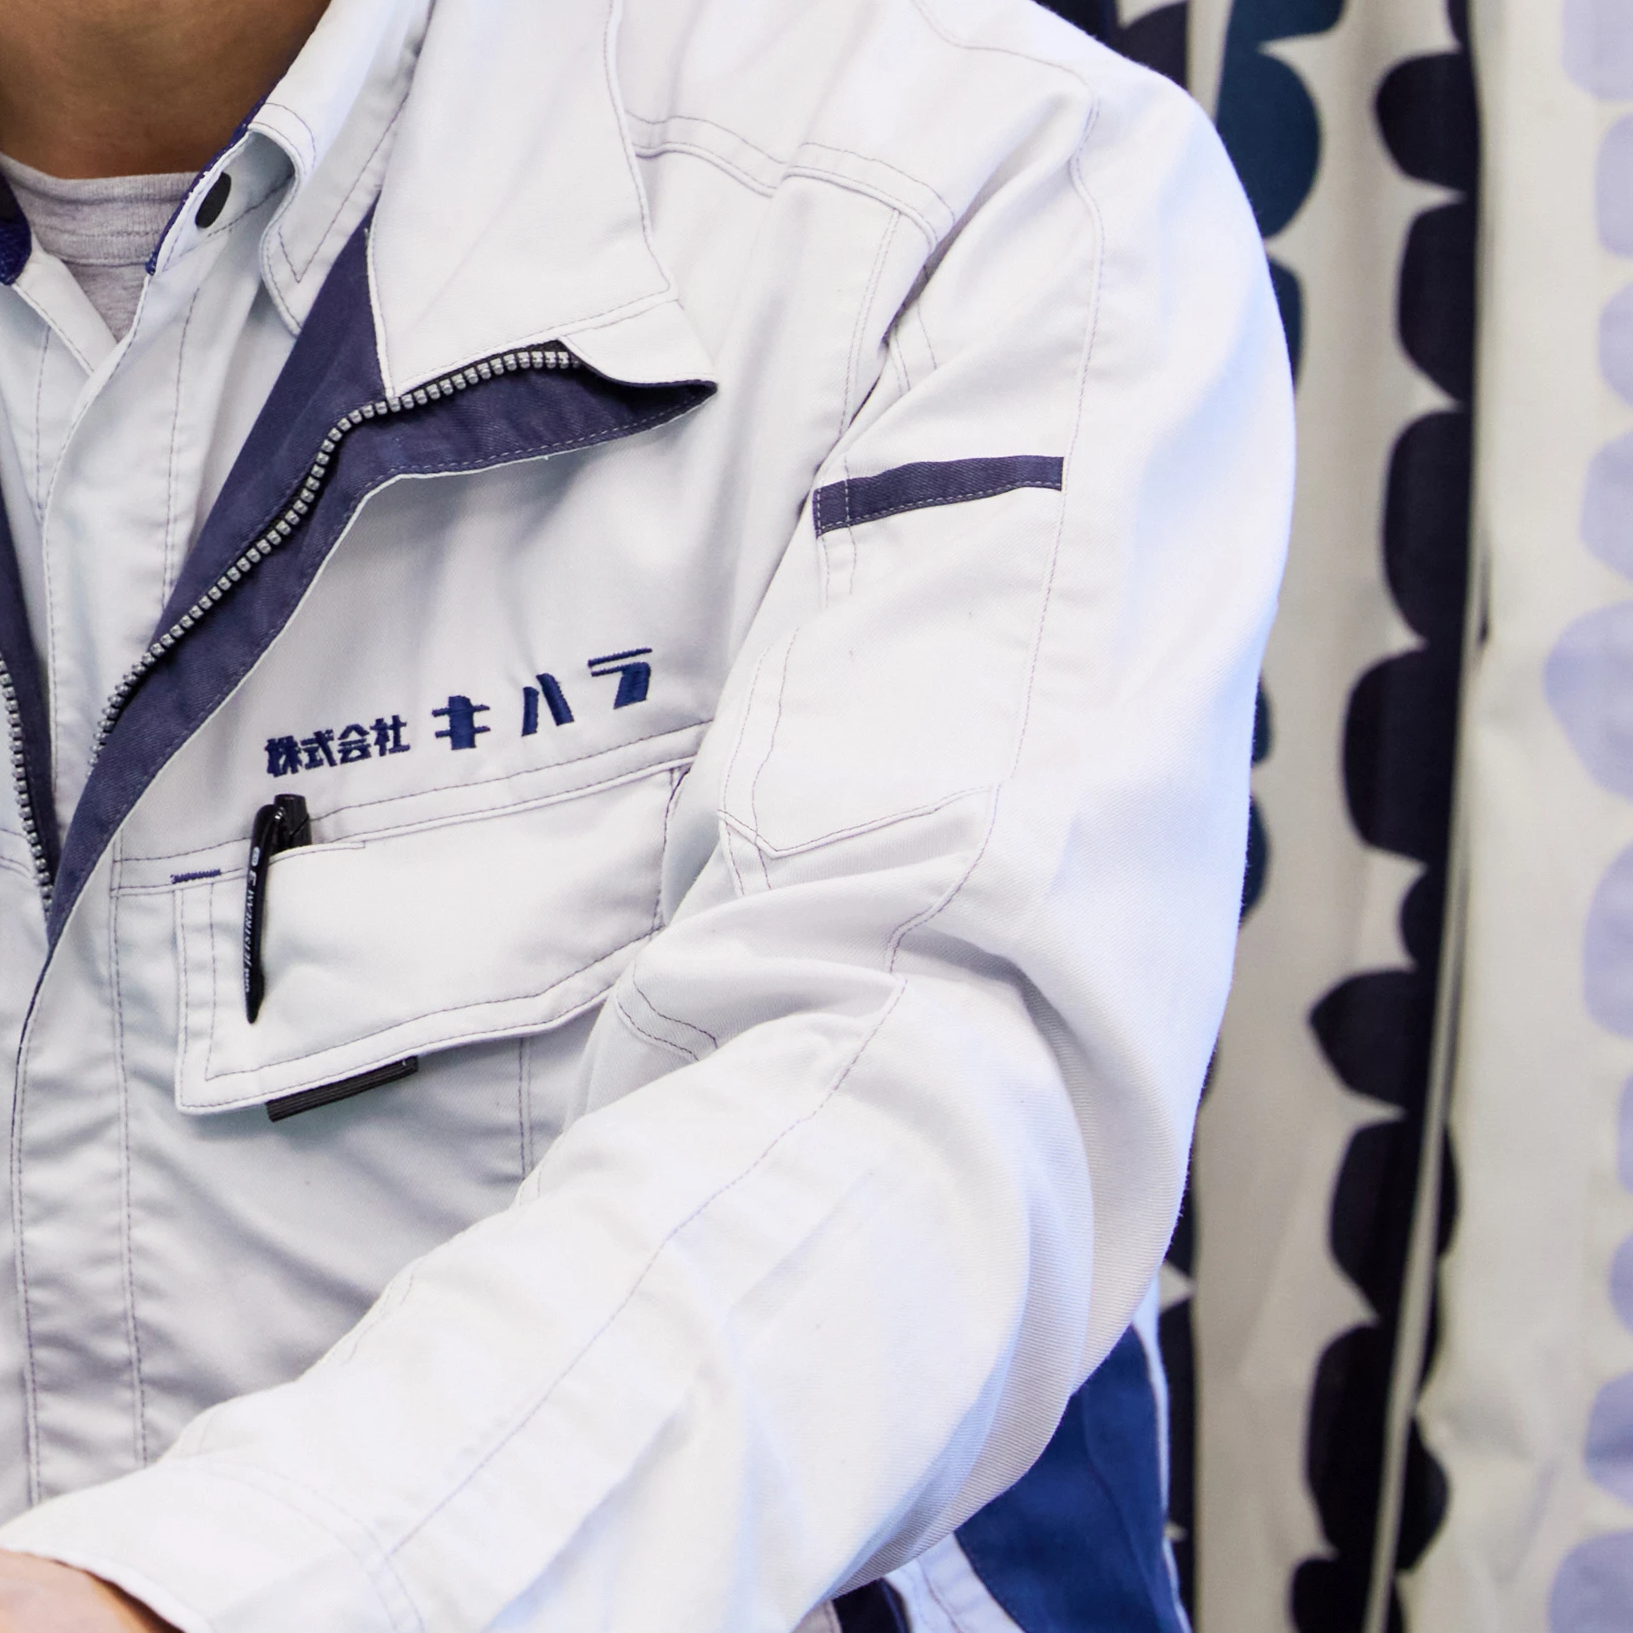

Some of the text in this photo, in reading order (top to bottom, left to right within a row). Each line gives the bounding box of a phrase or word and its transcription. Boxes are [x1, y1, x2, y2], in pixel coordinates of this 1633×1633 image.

[264, 647, 653, 778] 株式会社 キハラ
